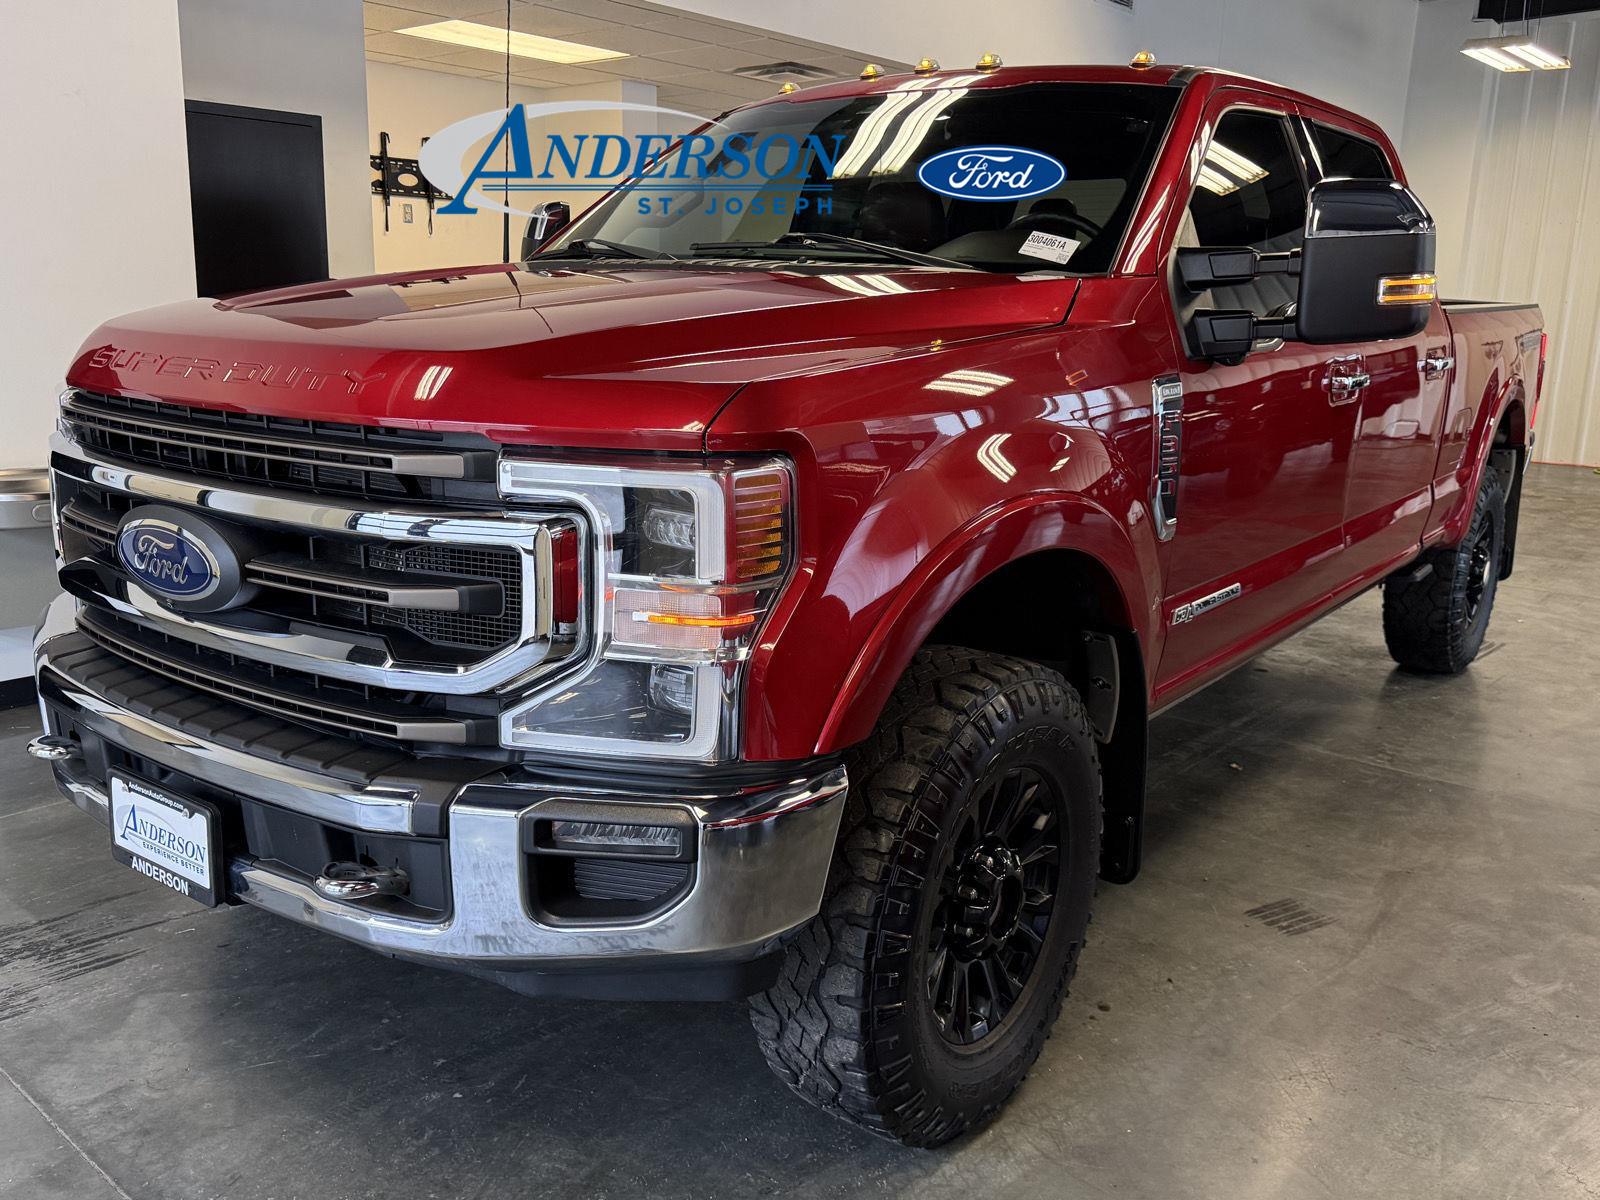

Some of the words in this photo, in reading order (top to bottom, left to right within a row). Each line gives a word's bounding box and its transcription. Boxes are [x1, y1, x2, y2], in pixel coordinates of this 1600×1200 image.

[1028, 234, 1067, 249] 3004061A
[88, 346, 221, 379] SUPER
[222, 361, 387, 395] DUTY
[133, 534, 189, 585] Ford
[120, 803, 206, 864] ANDERSON
[131, 856, 190, 896] ANDERSON
[142, 841, 179, 865] EXPERIENCE
[180, 858, 205, 876] BETTER
